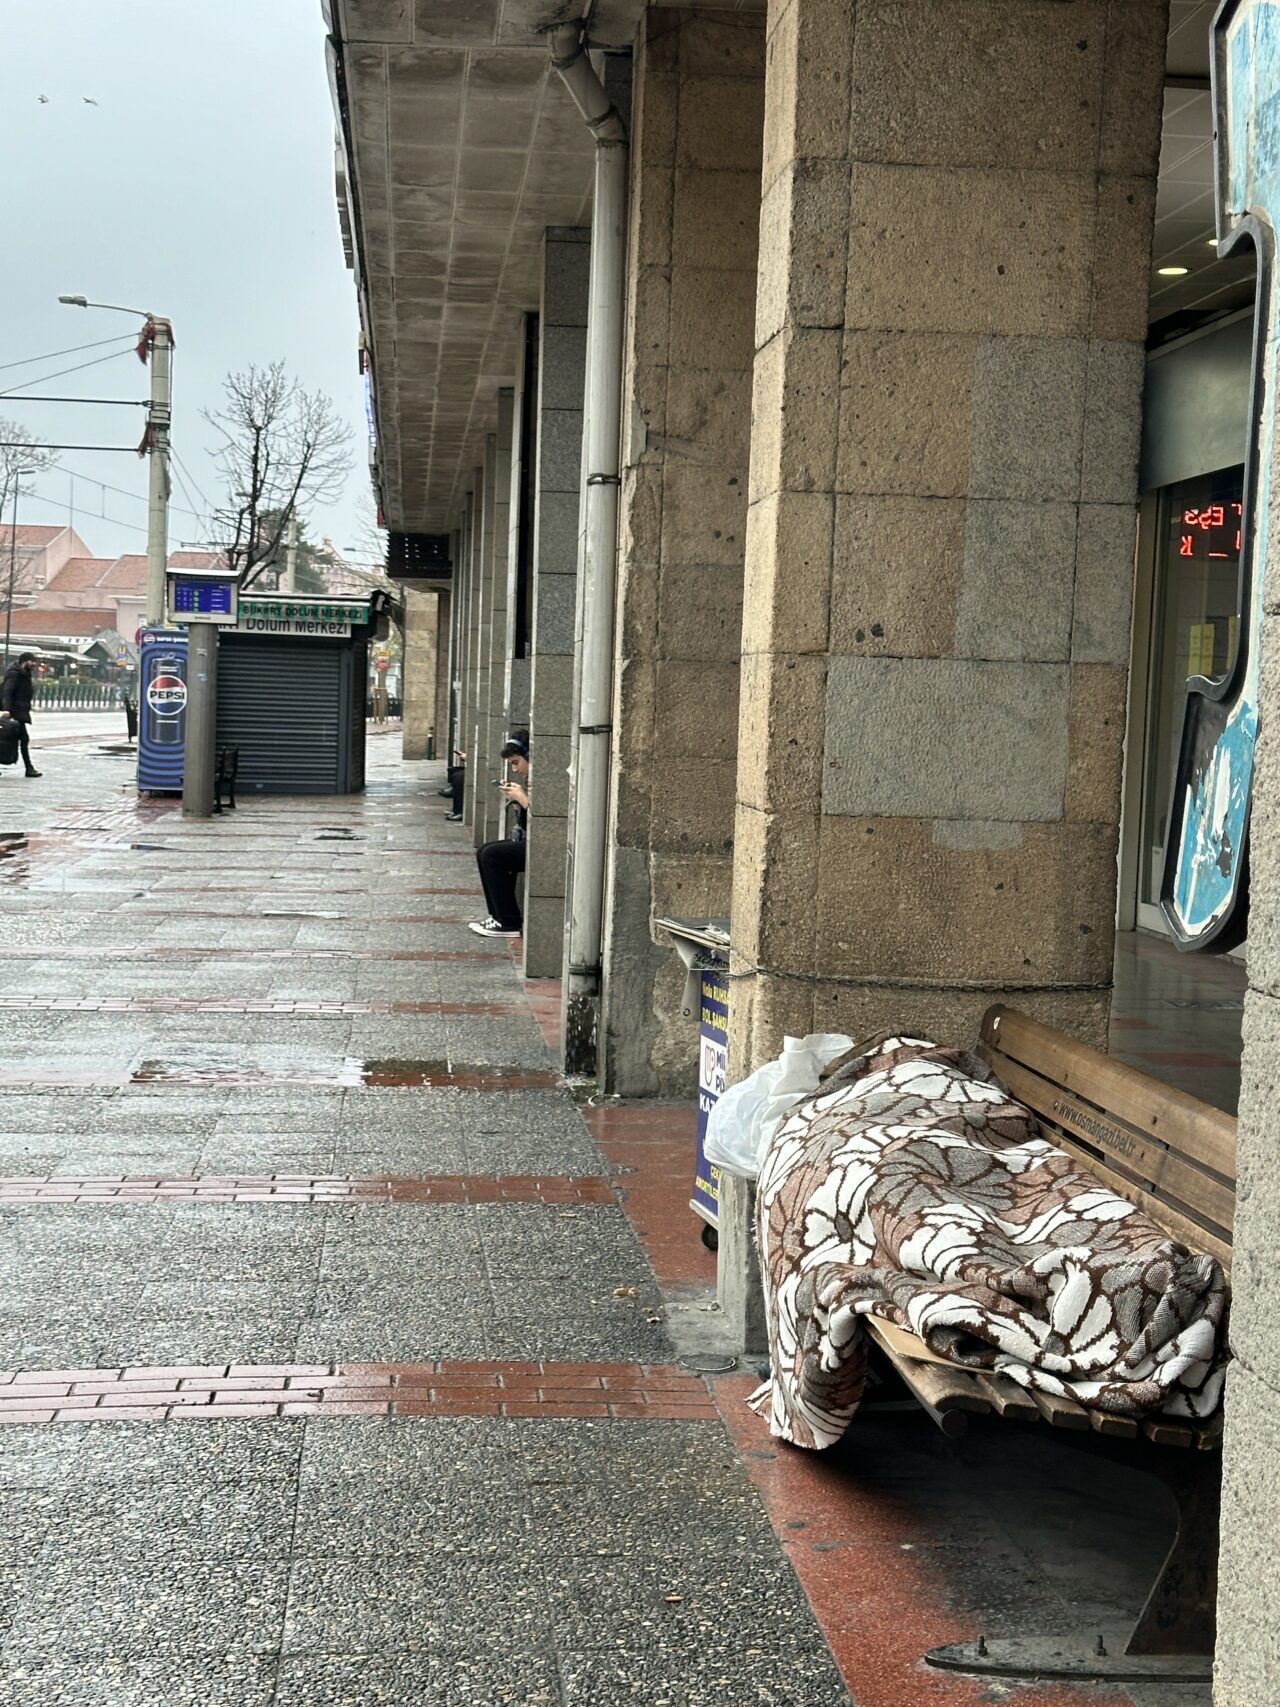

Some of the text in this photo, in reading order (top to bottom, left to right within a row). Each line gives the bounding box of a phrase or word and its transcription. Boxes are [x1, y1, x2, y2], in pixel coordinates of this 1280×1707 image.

[286, 607, 318, 617] DOLUM
[246, 619, 290, 632] Dolum
[149, 690, 185, 700] PEPSI
[1059, 1102, 1136, 1158] www.osmangazi.bel.tr
